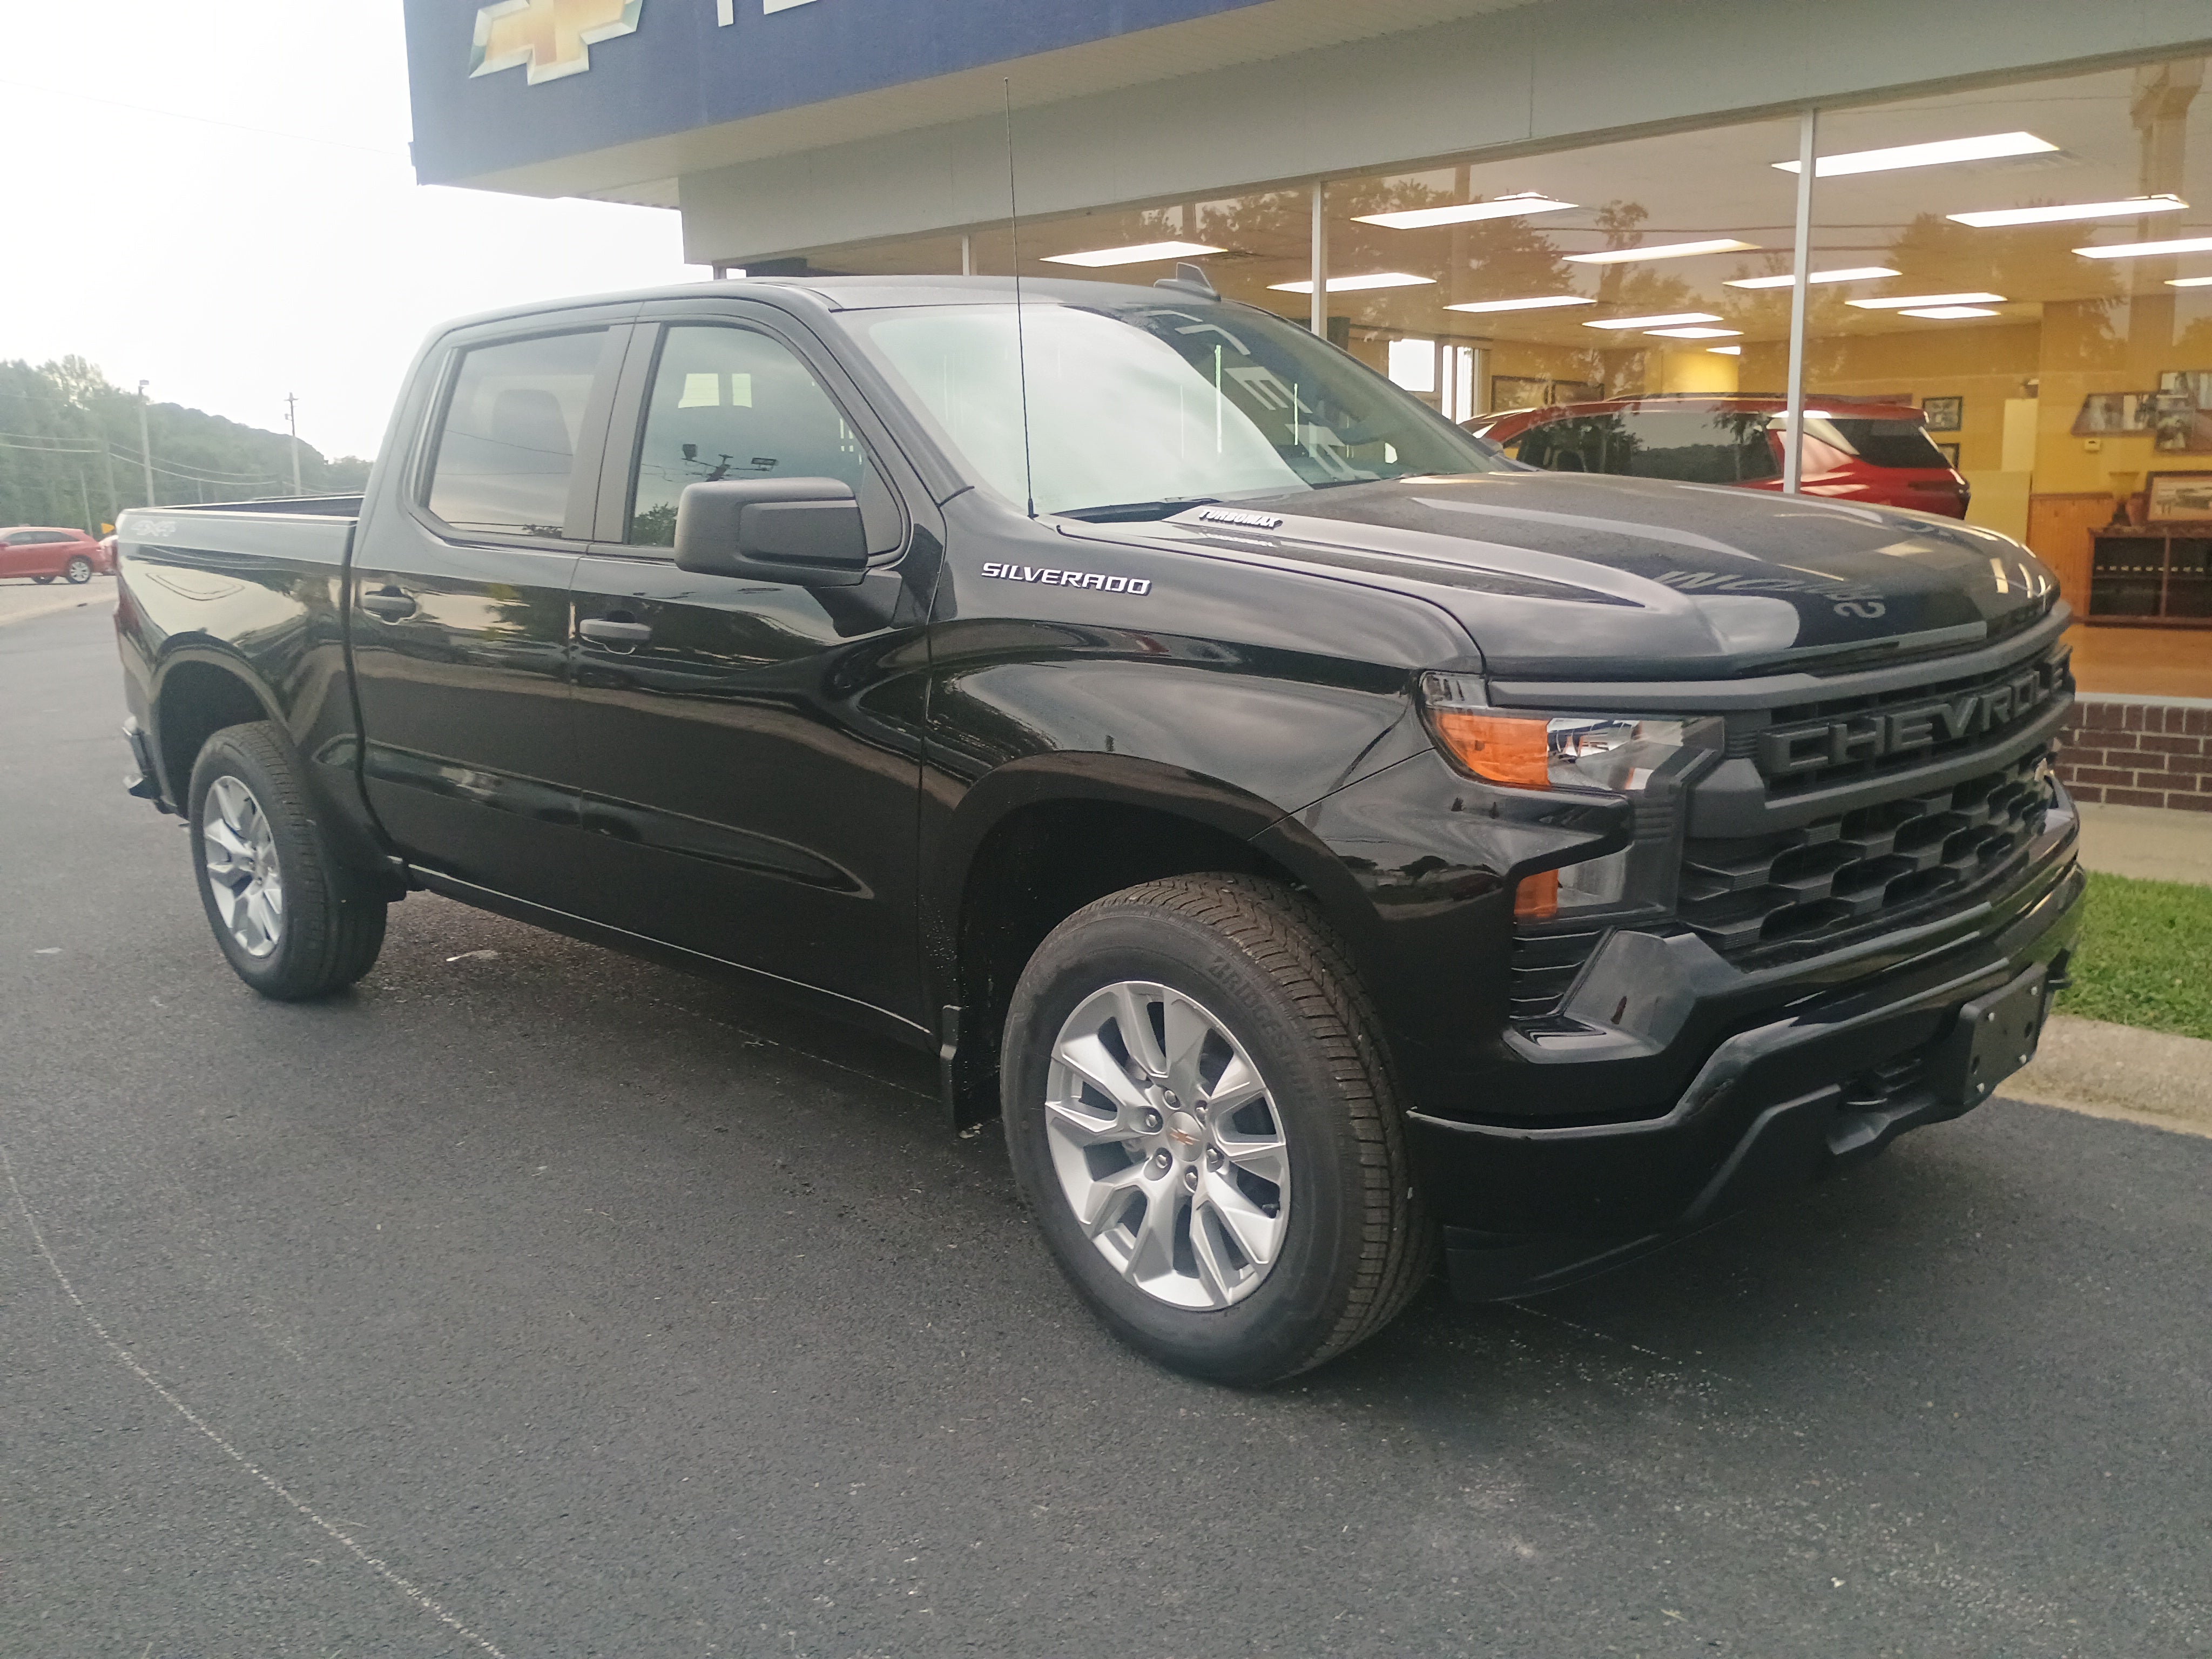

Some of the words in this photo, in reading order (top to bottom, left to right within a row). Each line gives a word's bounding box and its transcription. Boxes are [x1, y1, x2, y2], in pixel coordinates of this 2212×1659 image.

[1199, 509, 1283, 529] TURBOMAX
[981, 562, 1151, 596] SILVERADO
[1758, 645, 2073, 773] CHEVROLE
